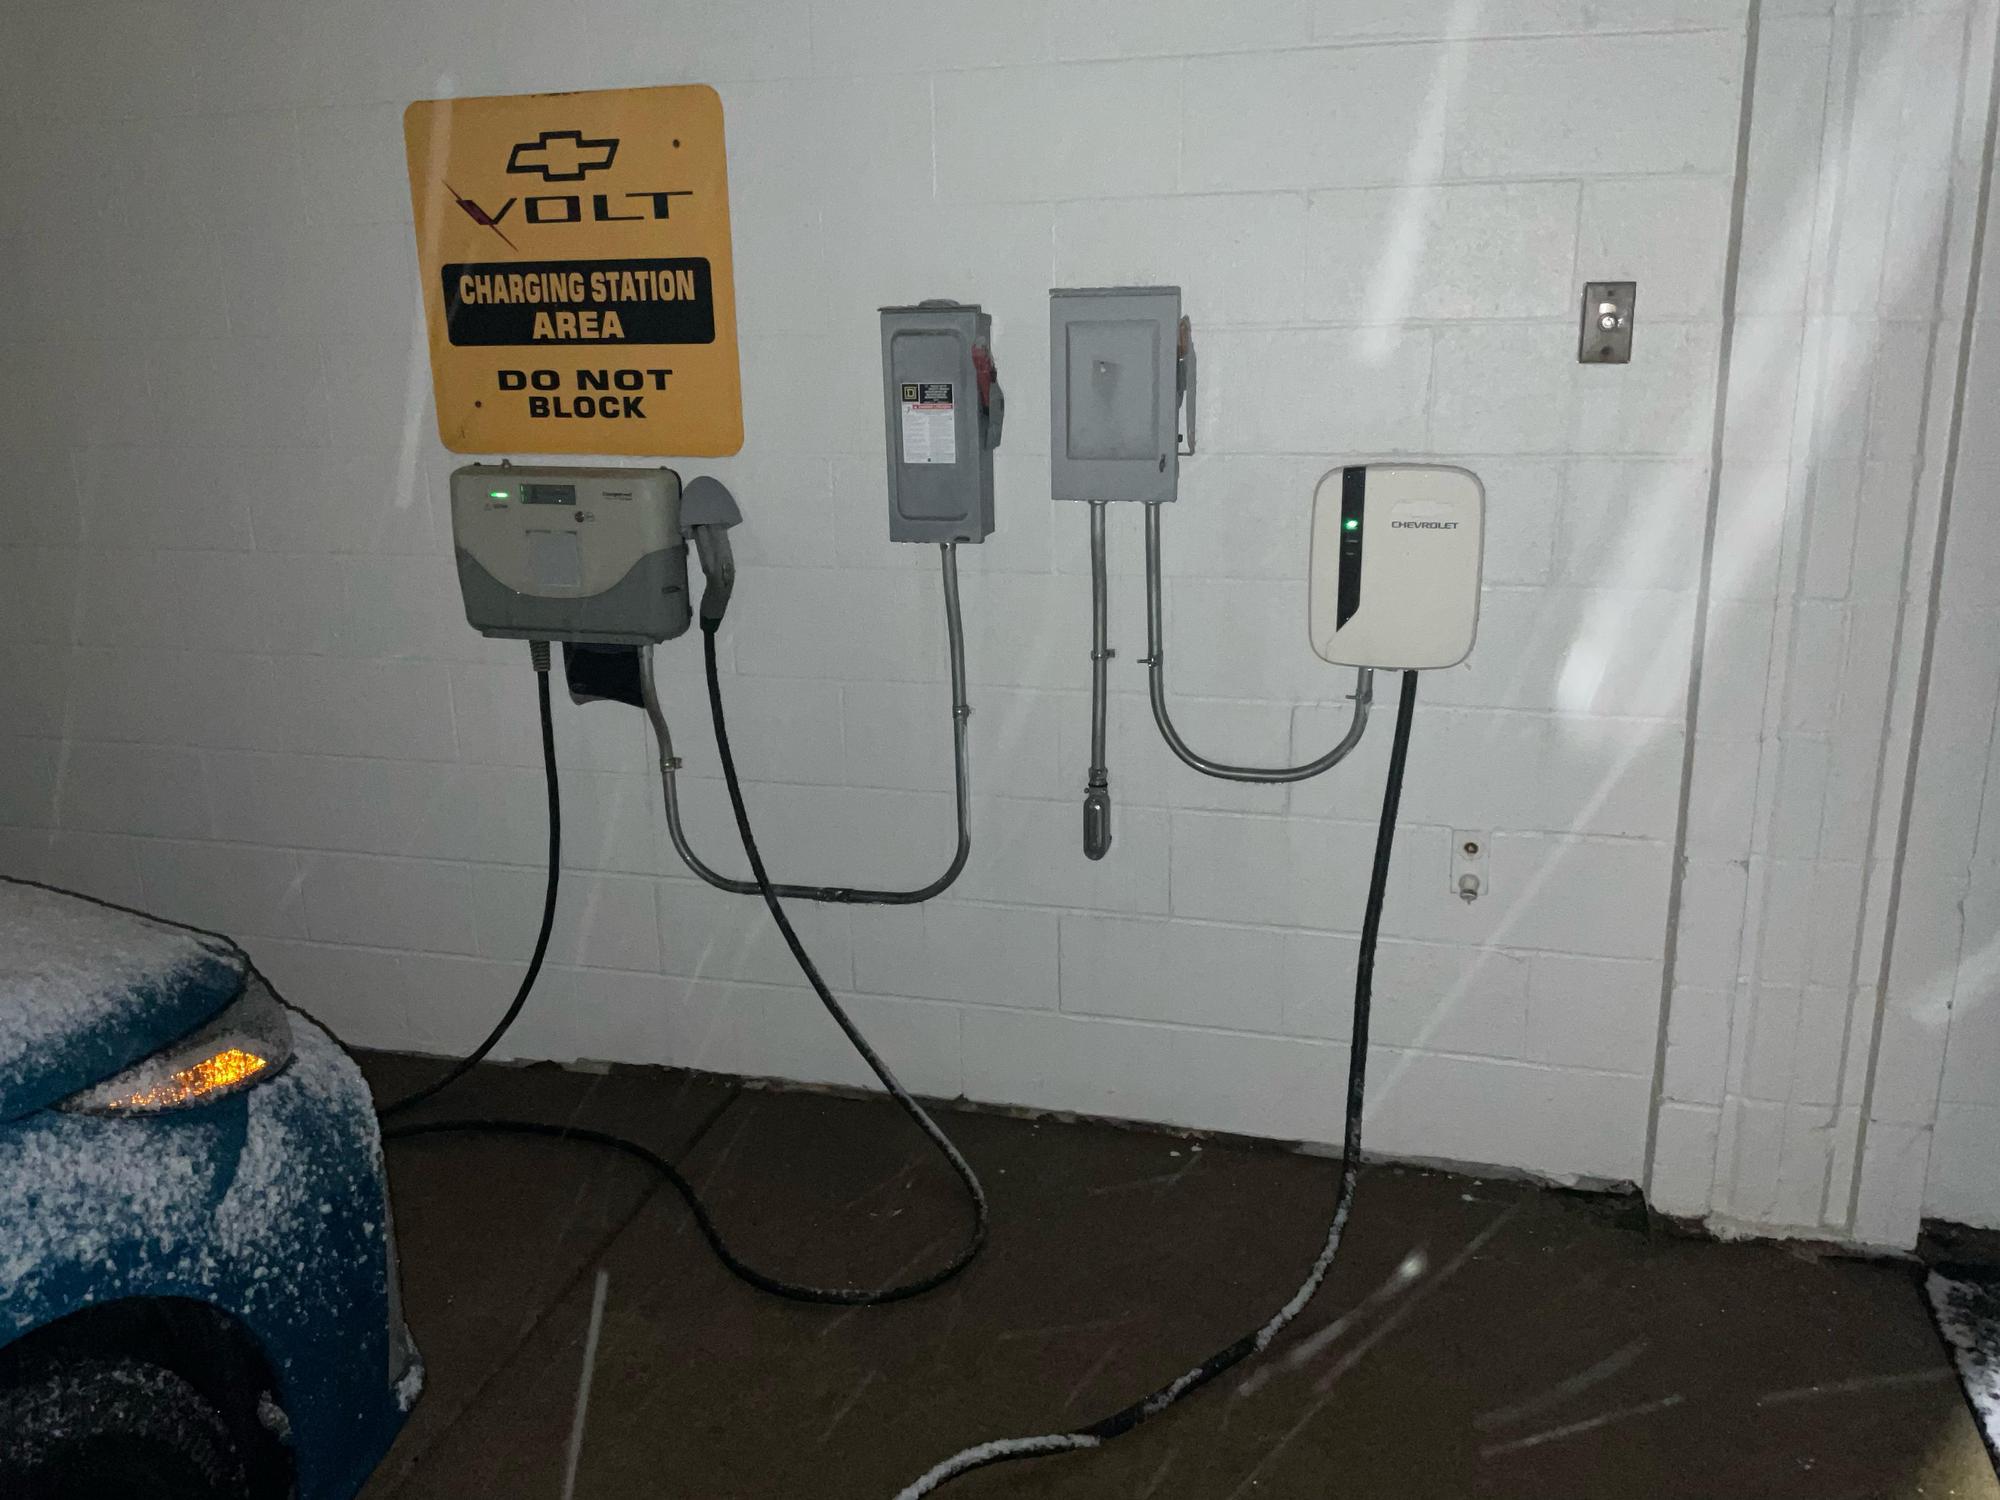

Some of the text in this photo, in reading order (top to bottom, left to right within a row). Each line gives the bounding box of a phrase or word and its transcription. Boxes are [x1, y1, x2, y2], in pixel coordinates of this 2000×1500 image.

[460, 270, 695, 305] CHARGING STATION
[532, 311, 625, 339] AREA
[498, 369, 673, 391] DO NOT
[529, 396, 647, 418] BLOCK
[1391, 521, 1459, 529] CHEVROLET
